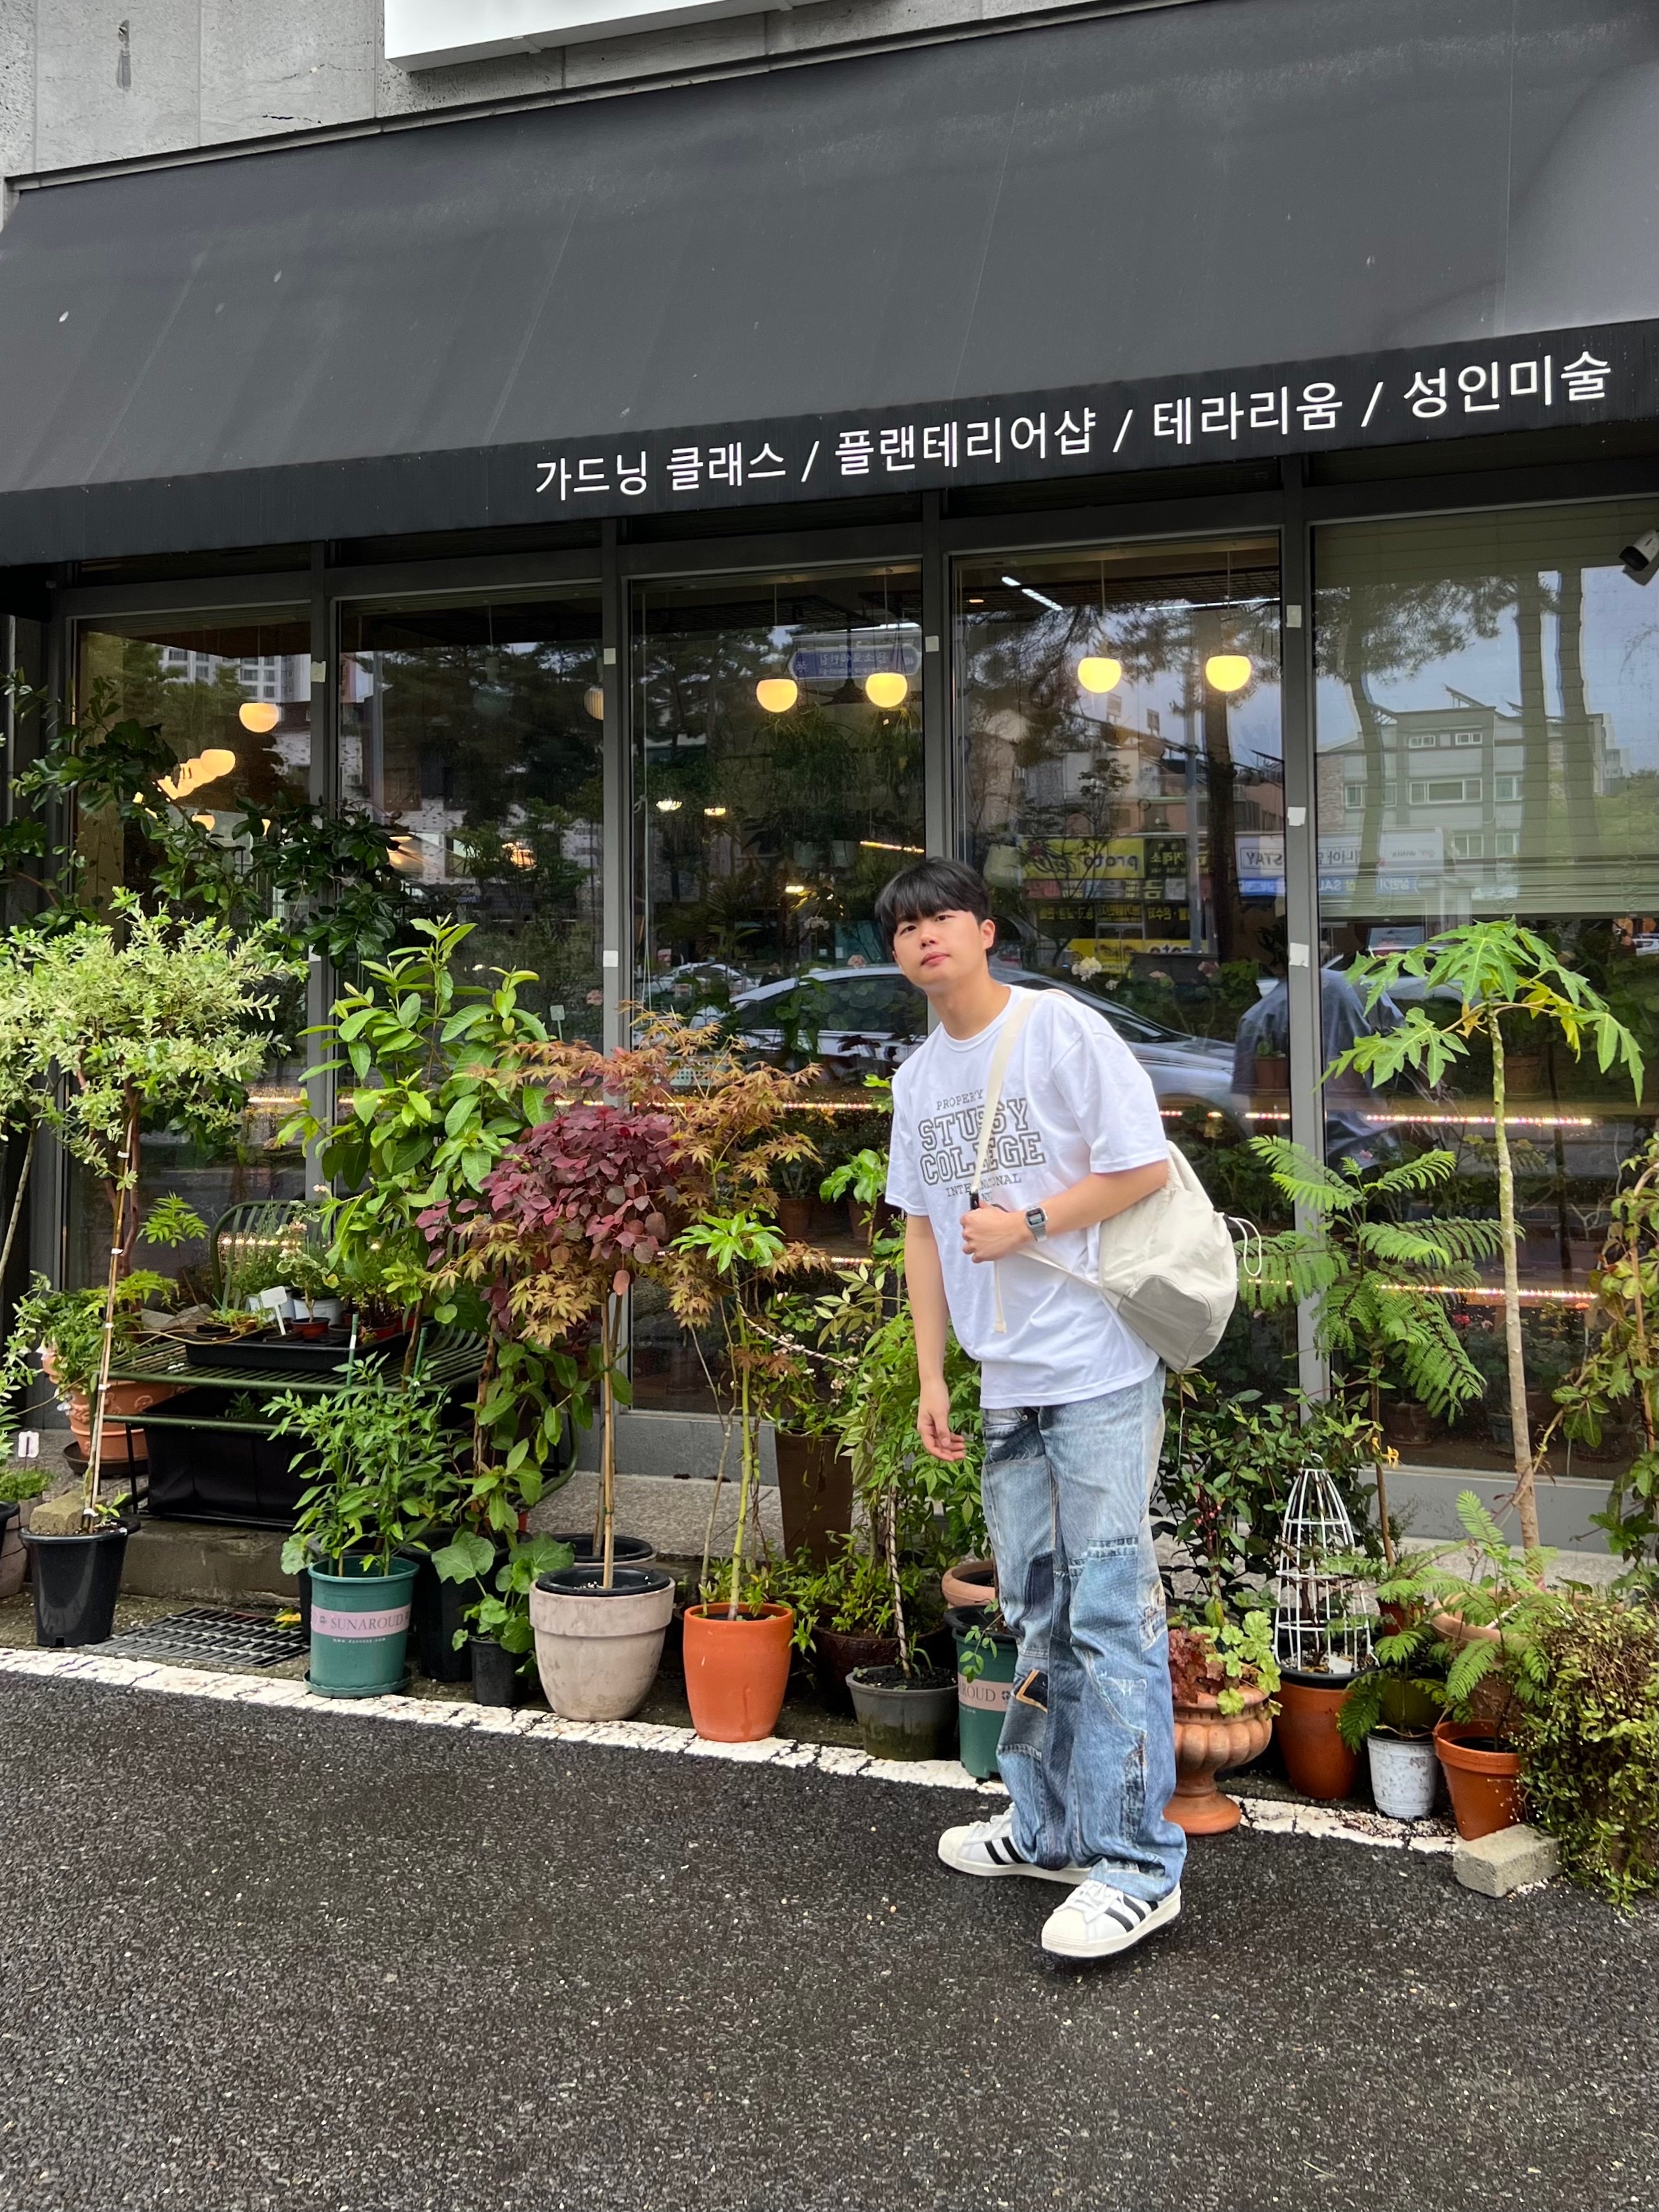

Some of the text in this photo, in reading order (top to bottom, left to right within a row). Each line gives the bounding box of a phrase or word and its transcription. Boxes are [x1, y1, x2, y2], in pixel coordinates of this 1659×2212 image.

[535, 350, 1613, 501] 가드닝 클래스 / 플랜테리어샵 / 테라리움 / 성인미술
[330, 1613, 403, 1631] SUNAROUD
